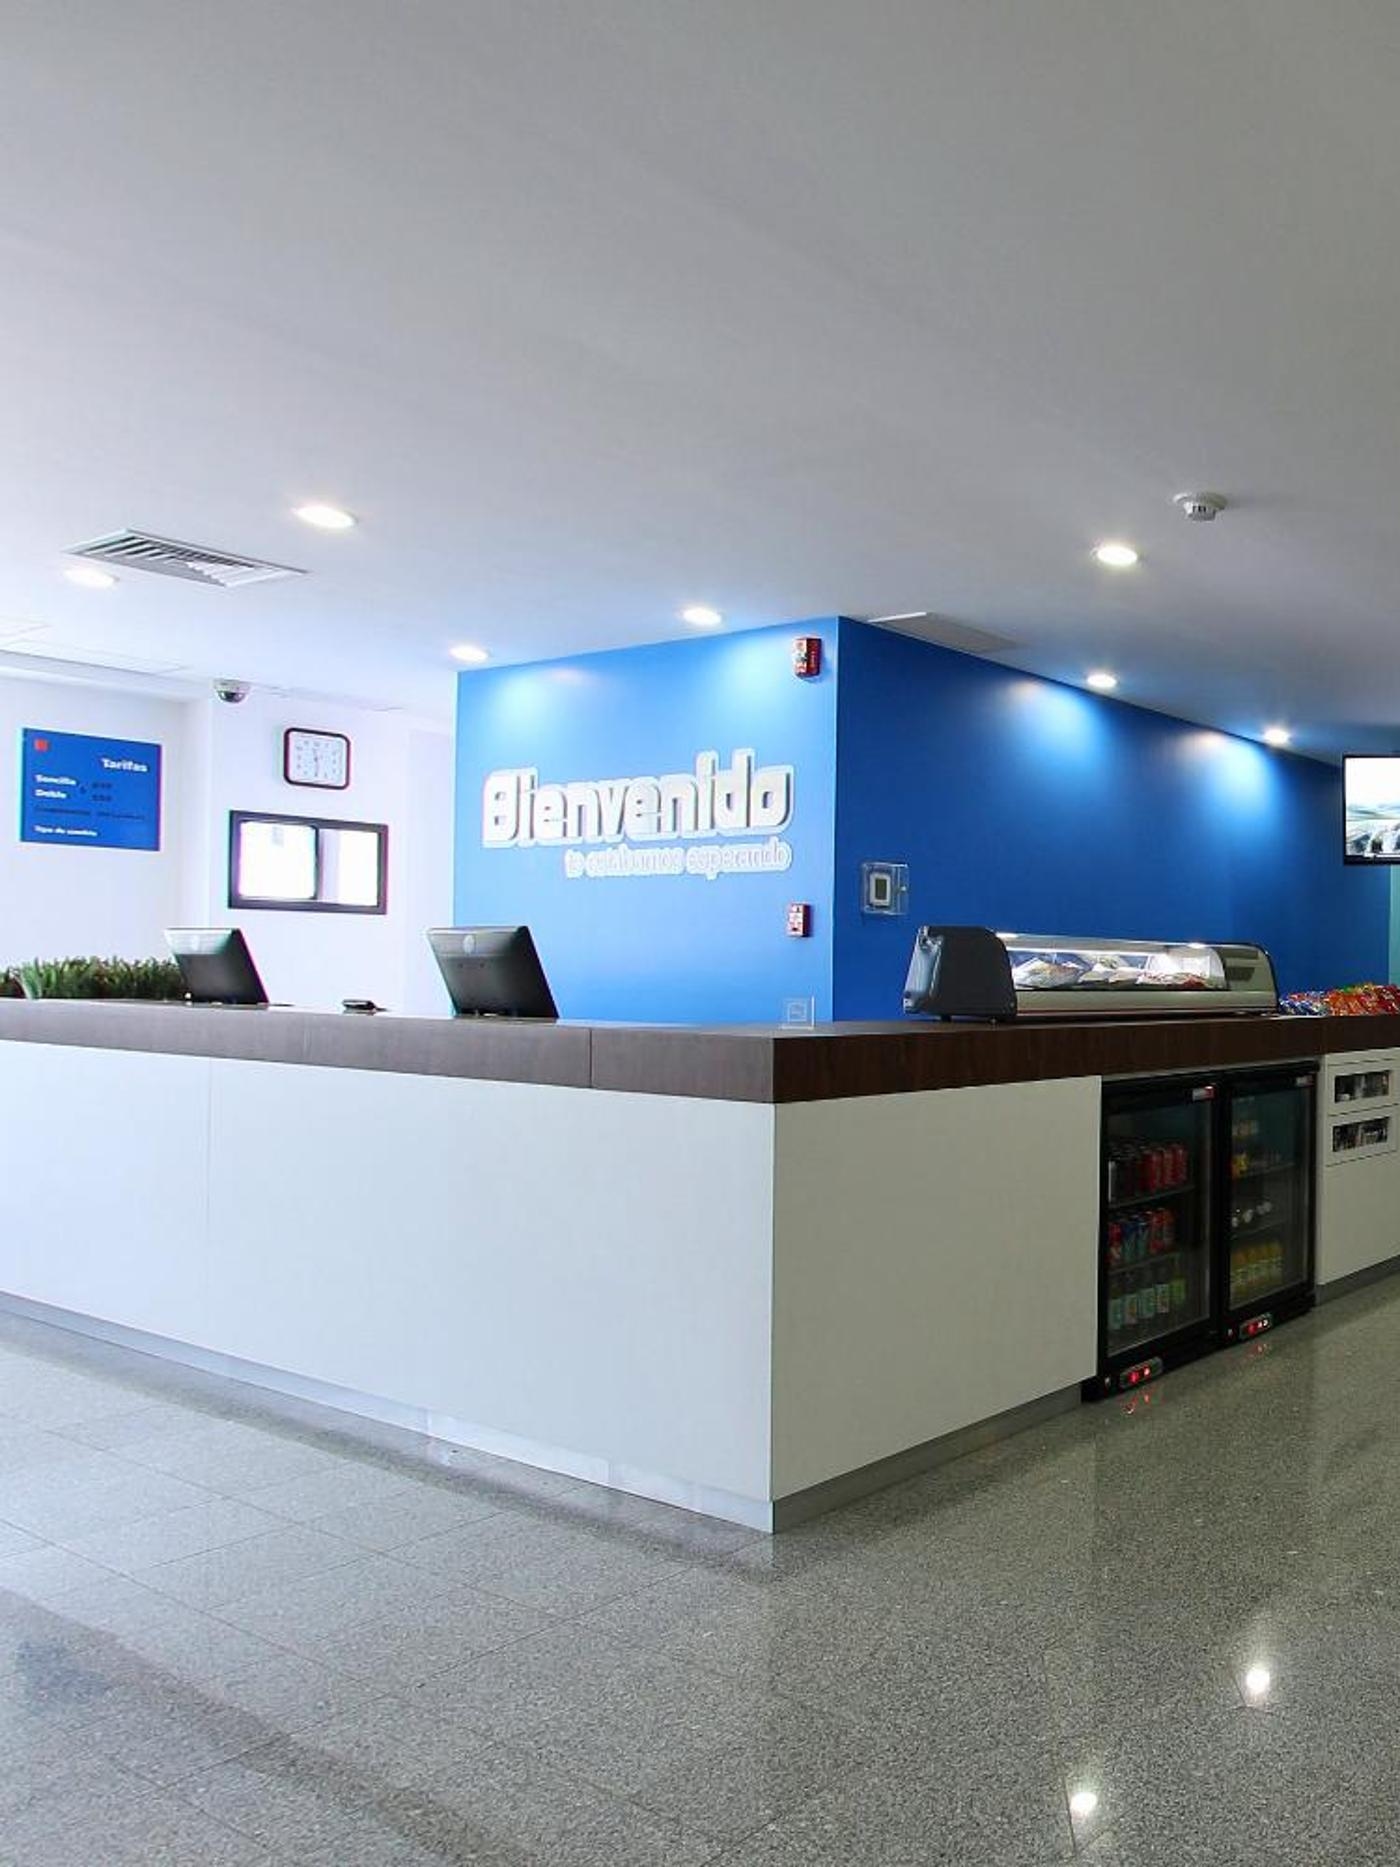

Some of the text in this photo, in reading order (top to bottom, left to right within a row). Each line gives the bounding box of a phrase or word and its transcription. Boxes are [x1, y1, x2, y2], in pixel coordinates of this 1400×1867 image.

[101, 757, 148, 772] Tarifas
[483, 749, 794, 847] Bienvenido
[686, 836, 792, 880] esperando
